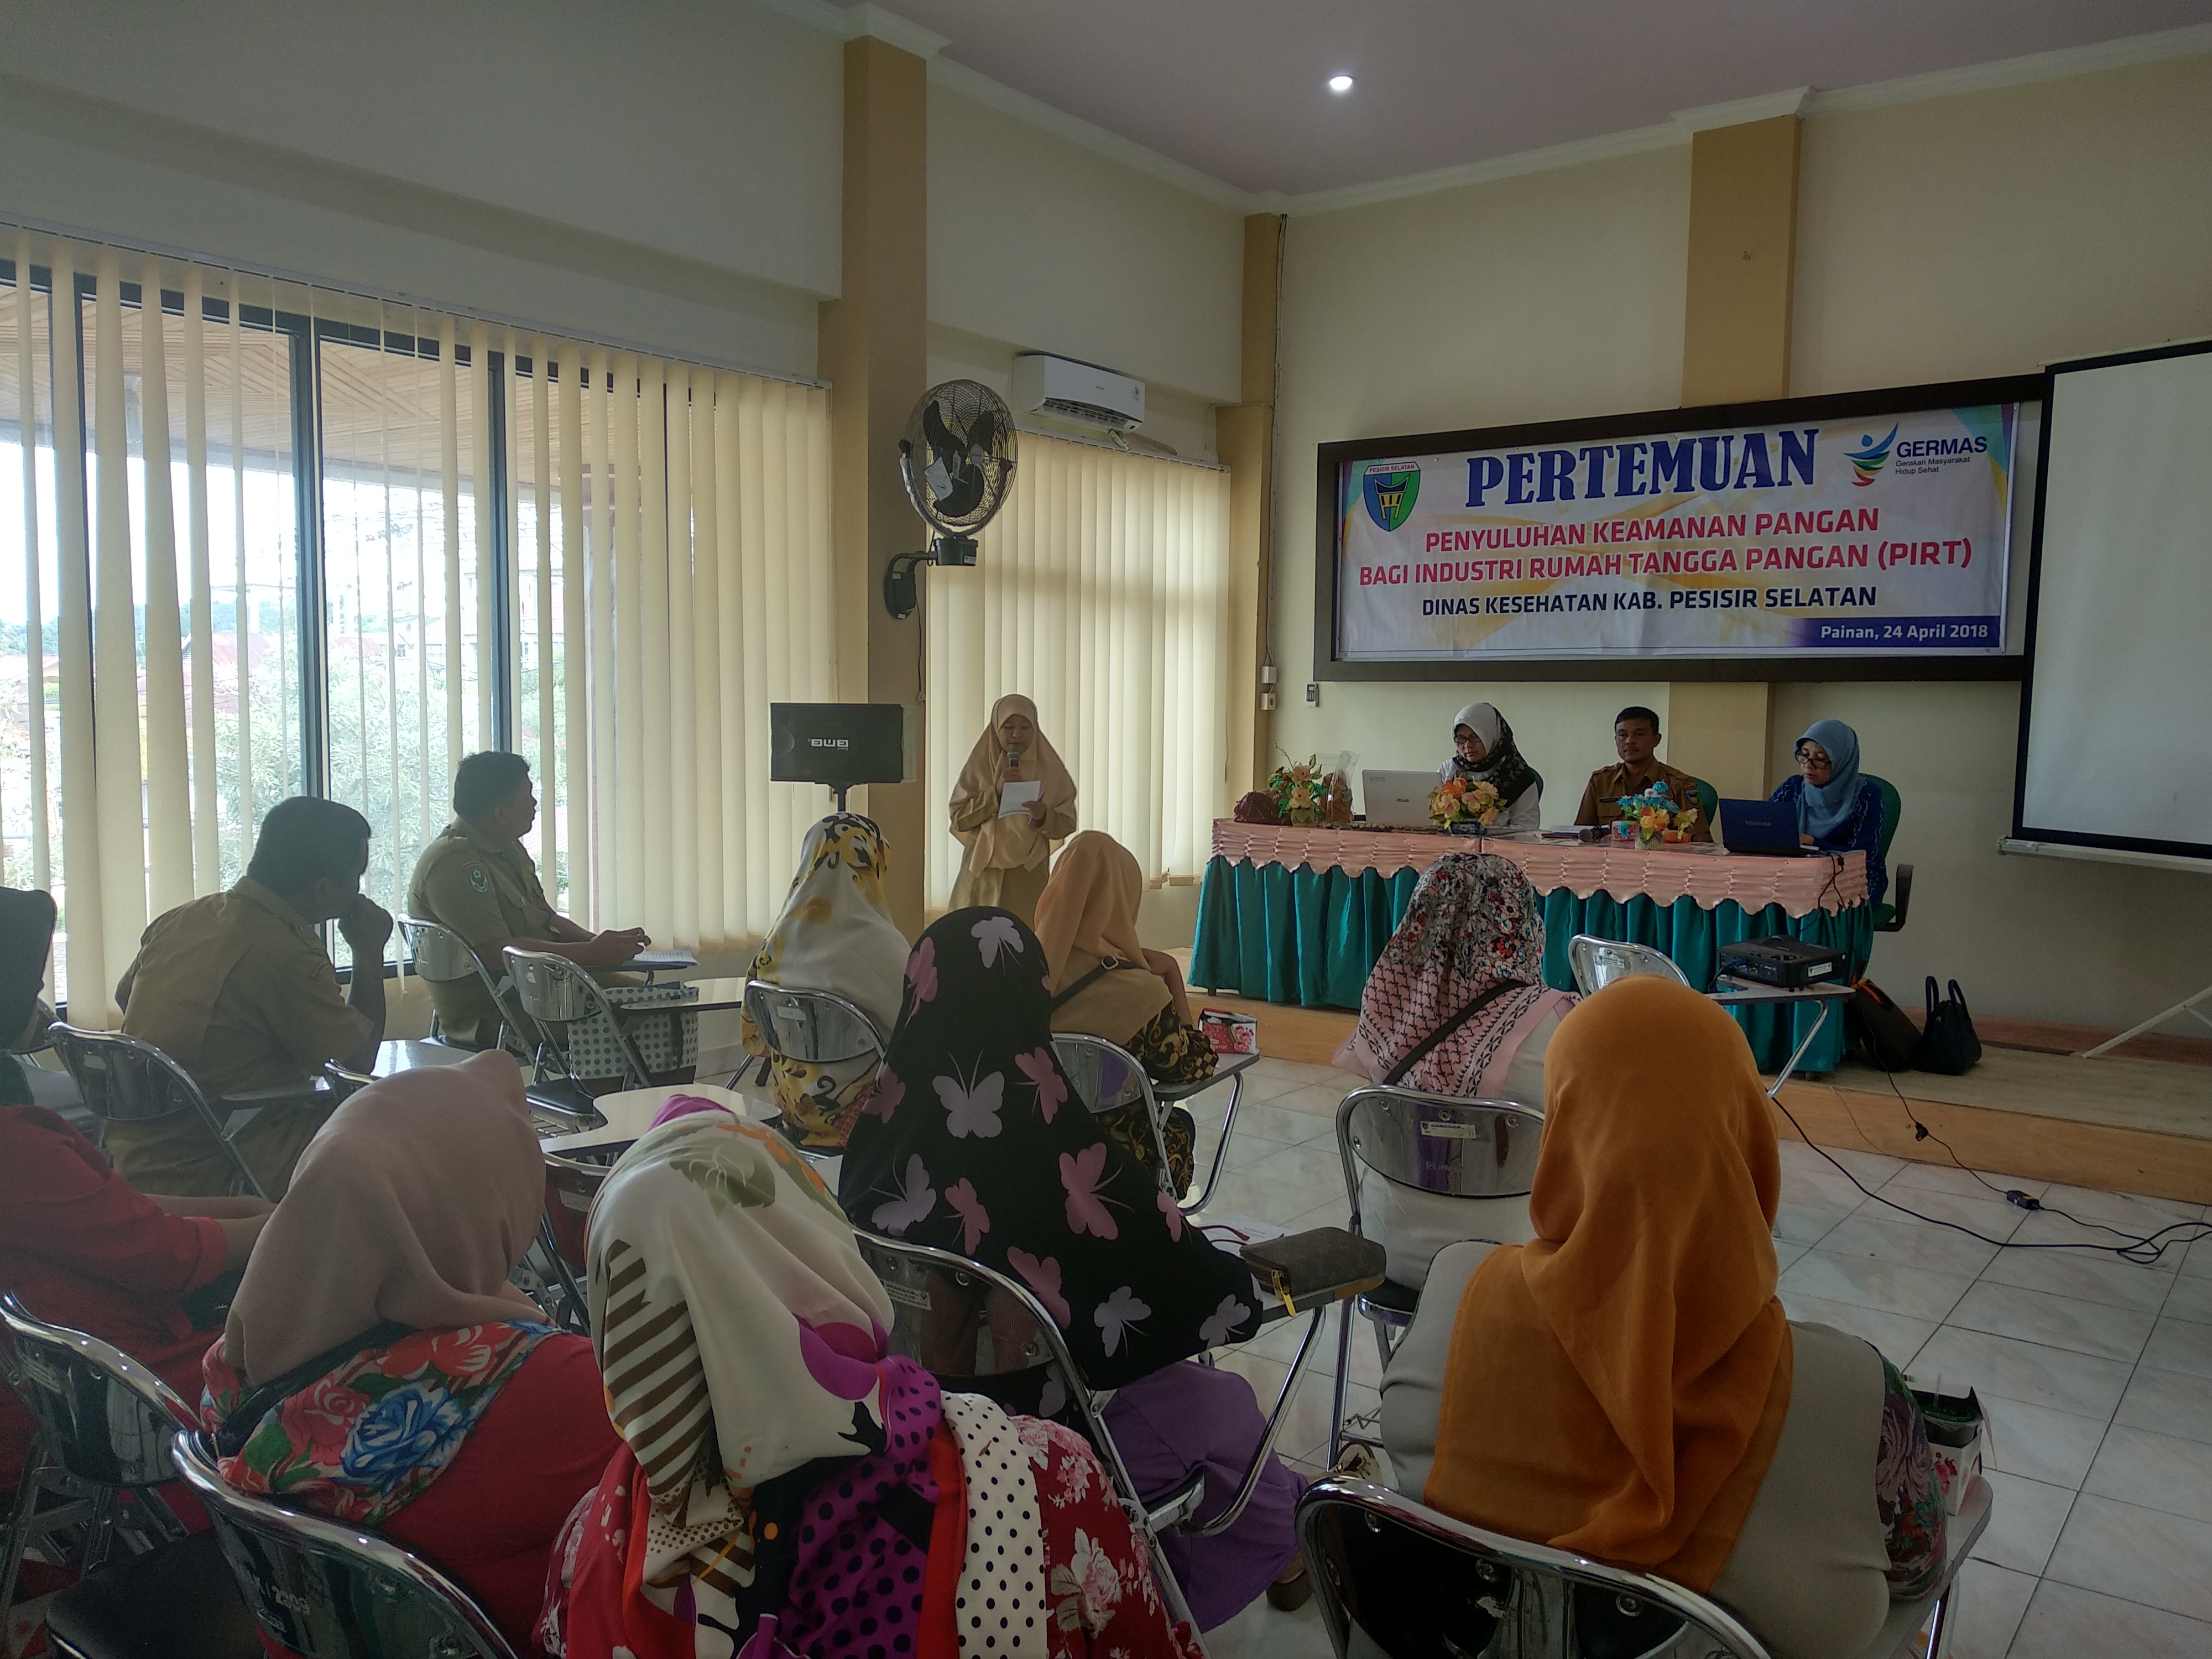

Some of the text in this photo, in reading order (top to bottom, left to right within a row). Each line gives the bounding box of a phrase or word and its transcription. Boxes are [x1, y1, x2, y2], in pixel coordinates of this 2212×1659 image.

[1896, 435, 1987, 458] GERMAS
[1465, 428, 1819, 508] PERTEMUAN
[1895, 456, 1970, 467] Gerakan Masyarakat
[1426, 508, 1879, 552] PENYULUHAN KEAMANAN PANGAN
[1359, 537, 1972, 586] BAGI INDUSTRI RUMAH TANGGA PANGAN (PIRT)
[1422, 586, 1877, 615] DINAS KESEHATAN KAB. PESISIR SELATAN
[1820, 624, 1989, 641] Painan, 24 April 2018
